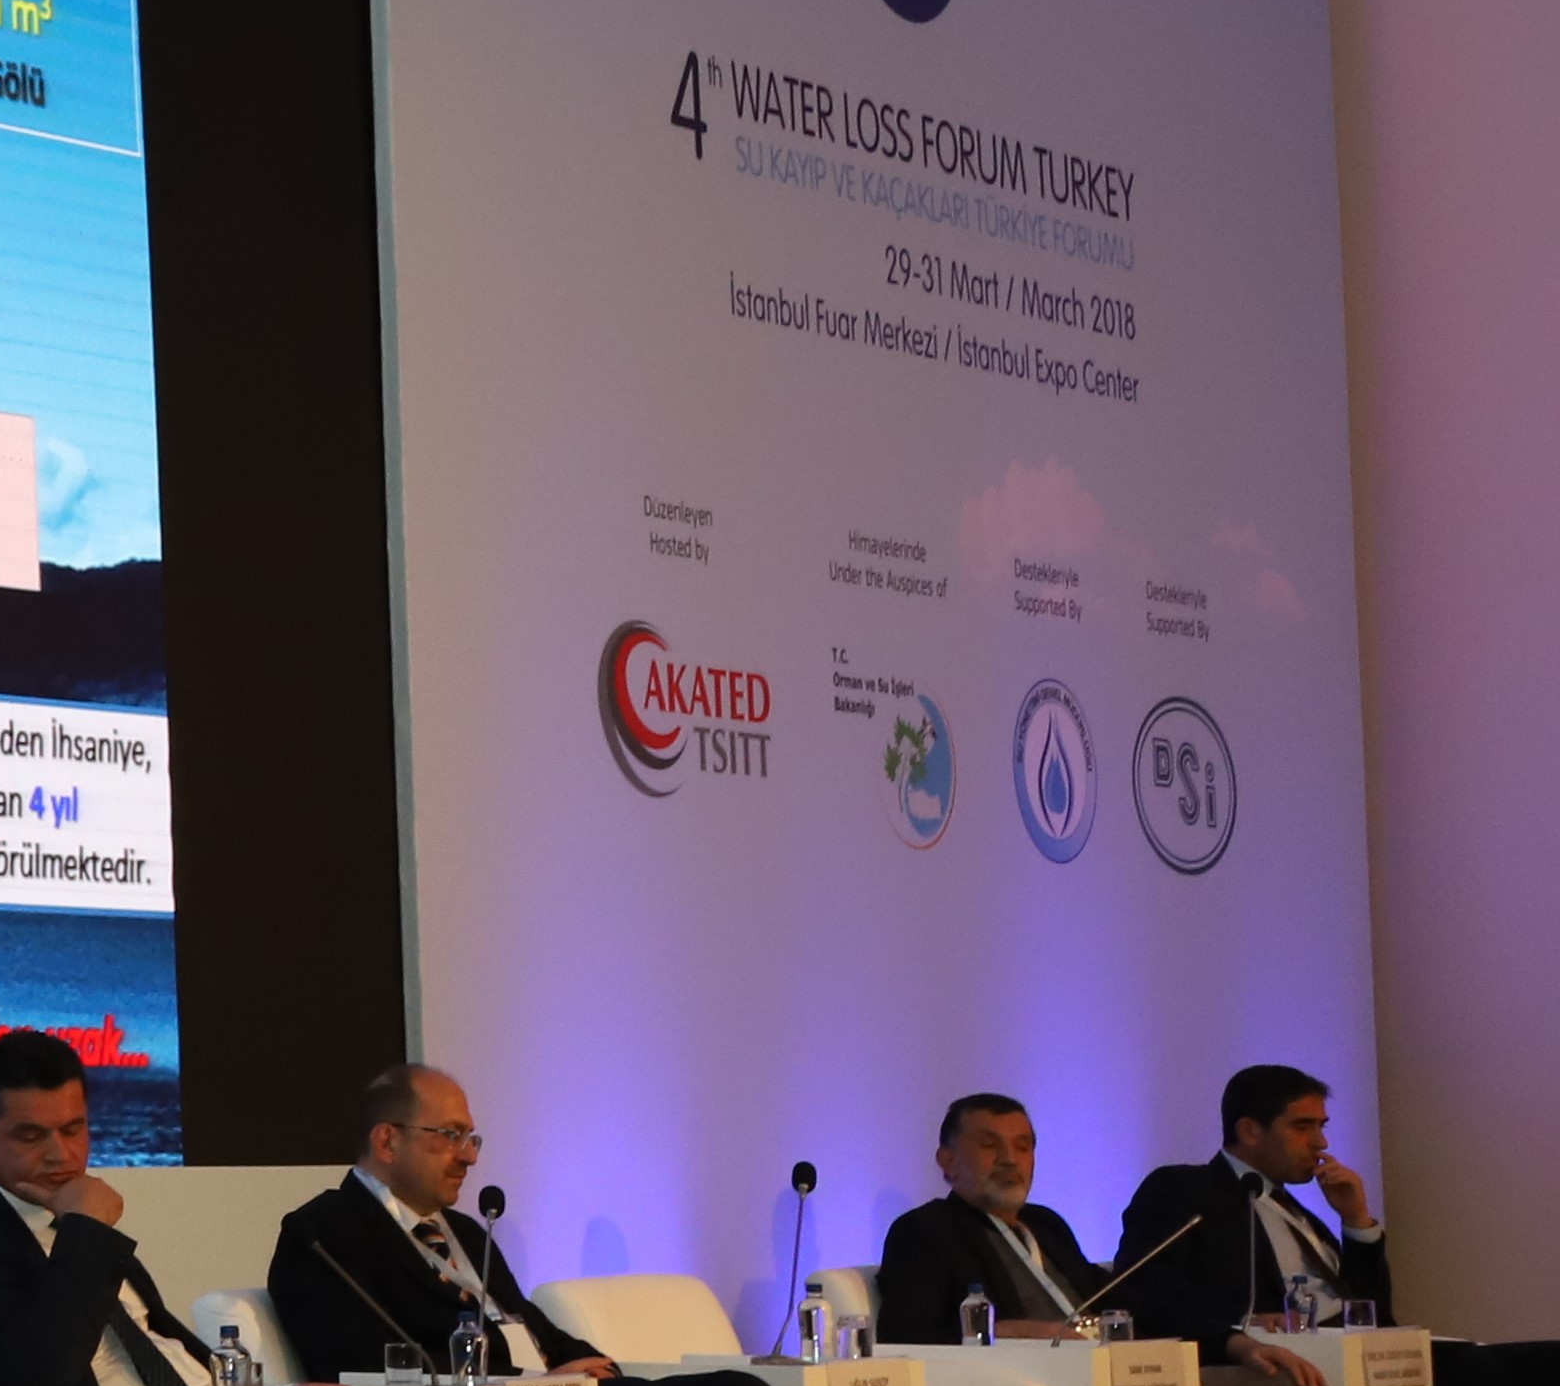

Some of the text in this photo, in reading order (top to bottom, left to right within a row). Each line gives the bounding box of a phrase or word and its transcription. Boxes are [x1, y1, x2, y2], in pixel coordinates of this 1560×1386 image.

[731, 60, 1134, 221] WATER LOSS FORUM TURKEY
[885, 245, 1137, 340] 29-31 Mart March 2018
[730, 270, 1139, 402] İstanbul Fuar Merkezi İstanbul Expo Center
[650, 532, 709, 566] Hosted by
[829, 560, 862, 585] Under
[865, 567, 884, 589] the
[937, 577, 948, 598] of
[644, 660, 771, 724] AKATED
[51, 718, 152, 773] İhsaniye,
[694, 727, 771, 778] TSITT
[29, 786, 44, 819] 4
[51, 786, 79, 829] yıl
